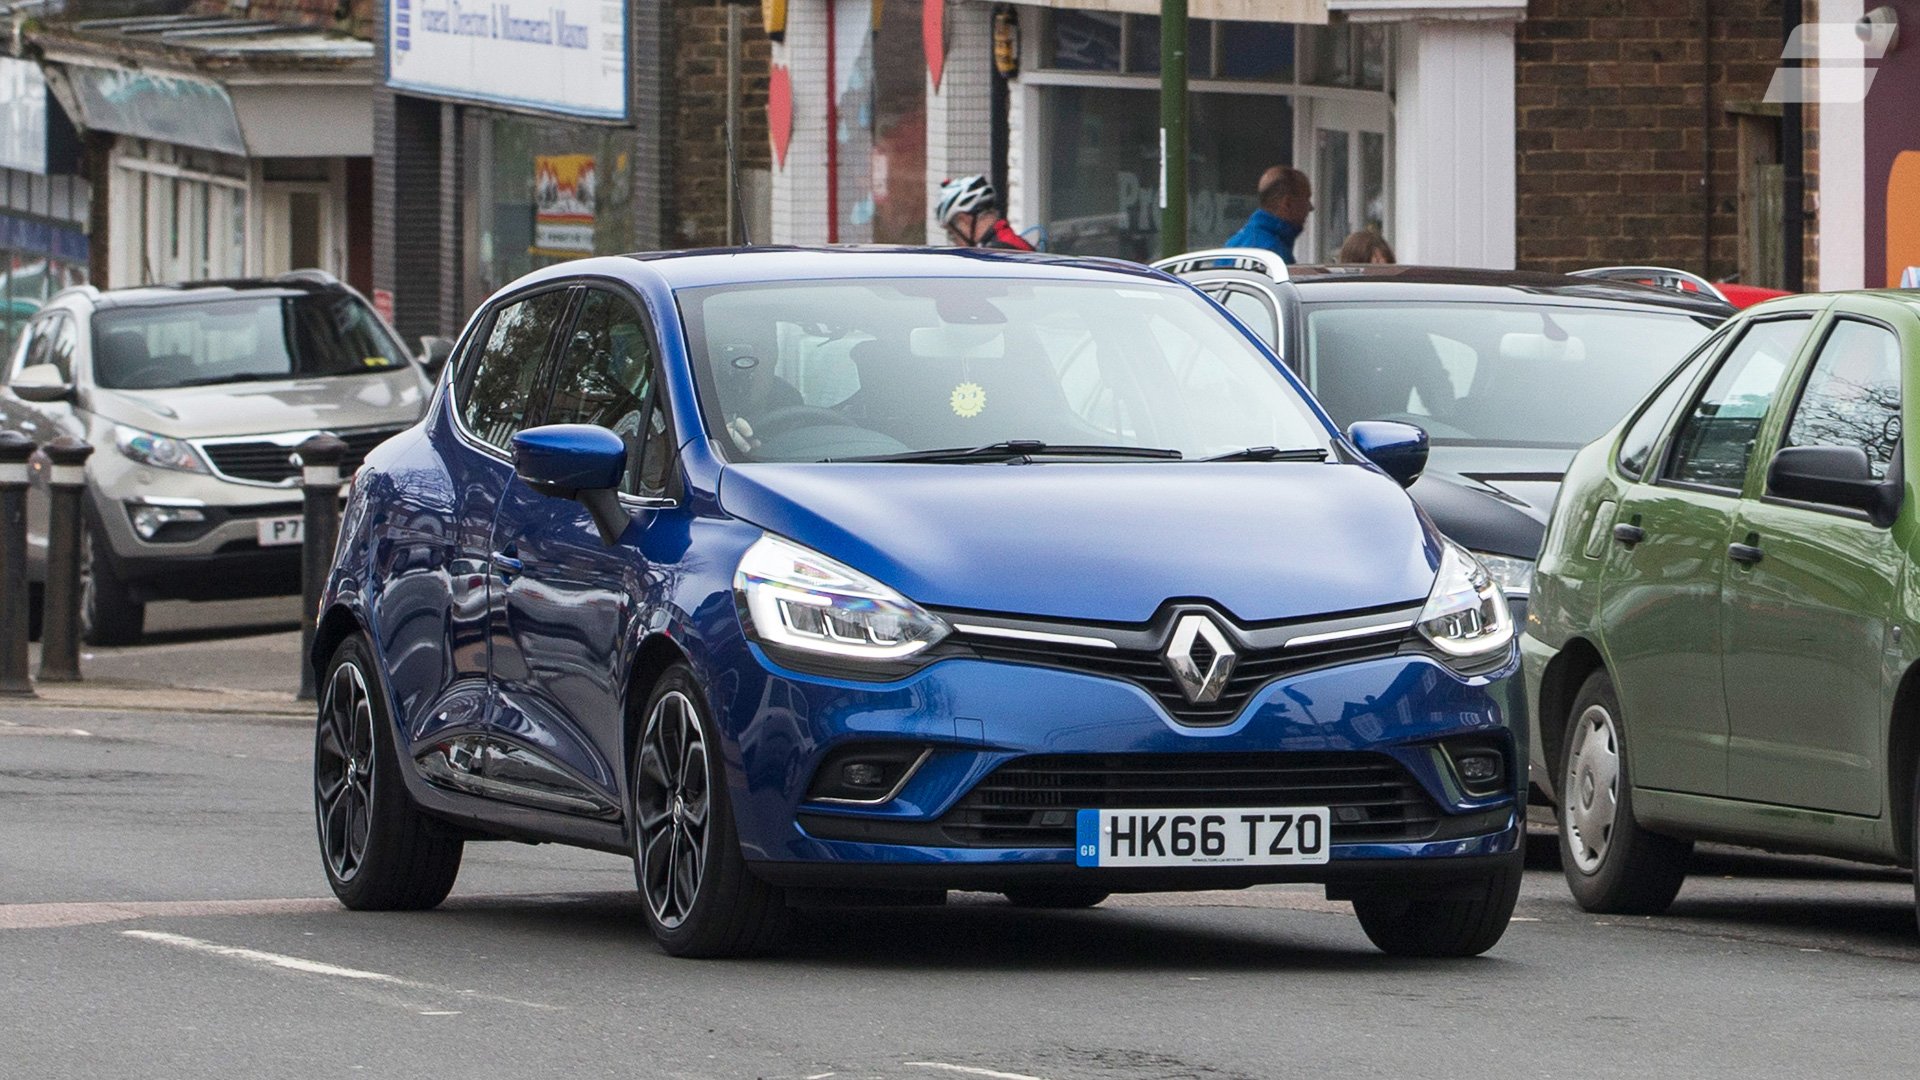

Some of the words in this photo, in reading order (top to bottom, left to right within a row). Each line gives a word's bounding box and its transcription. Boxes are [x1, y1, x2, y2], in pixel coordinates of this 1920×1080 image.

[501, 4, 553, 45] Monumental
[555, 9, 589, 50] Masons
[1080, 845, 1096, 857] GB
[1110, 815, 1226, 857] HK66
[1240, 814, 1322, 856] TZO
